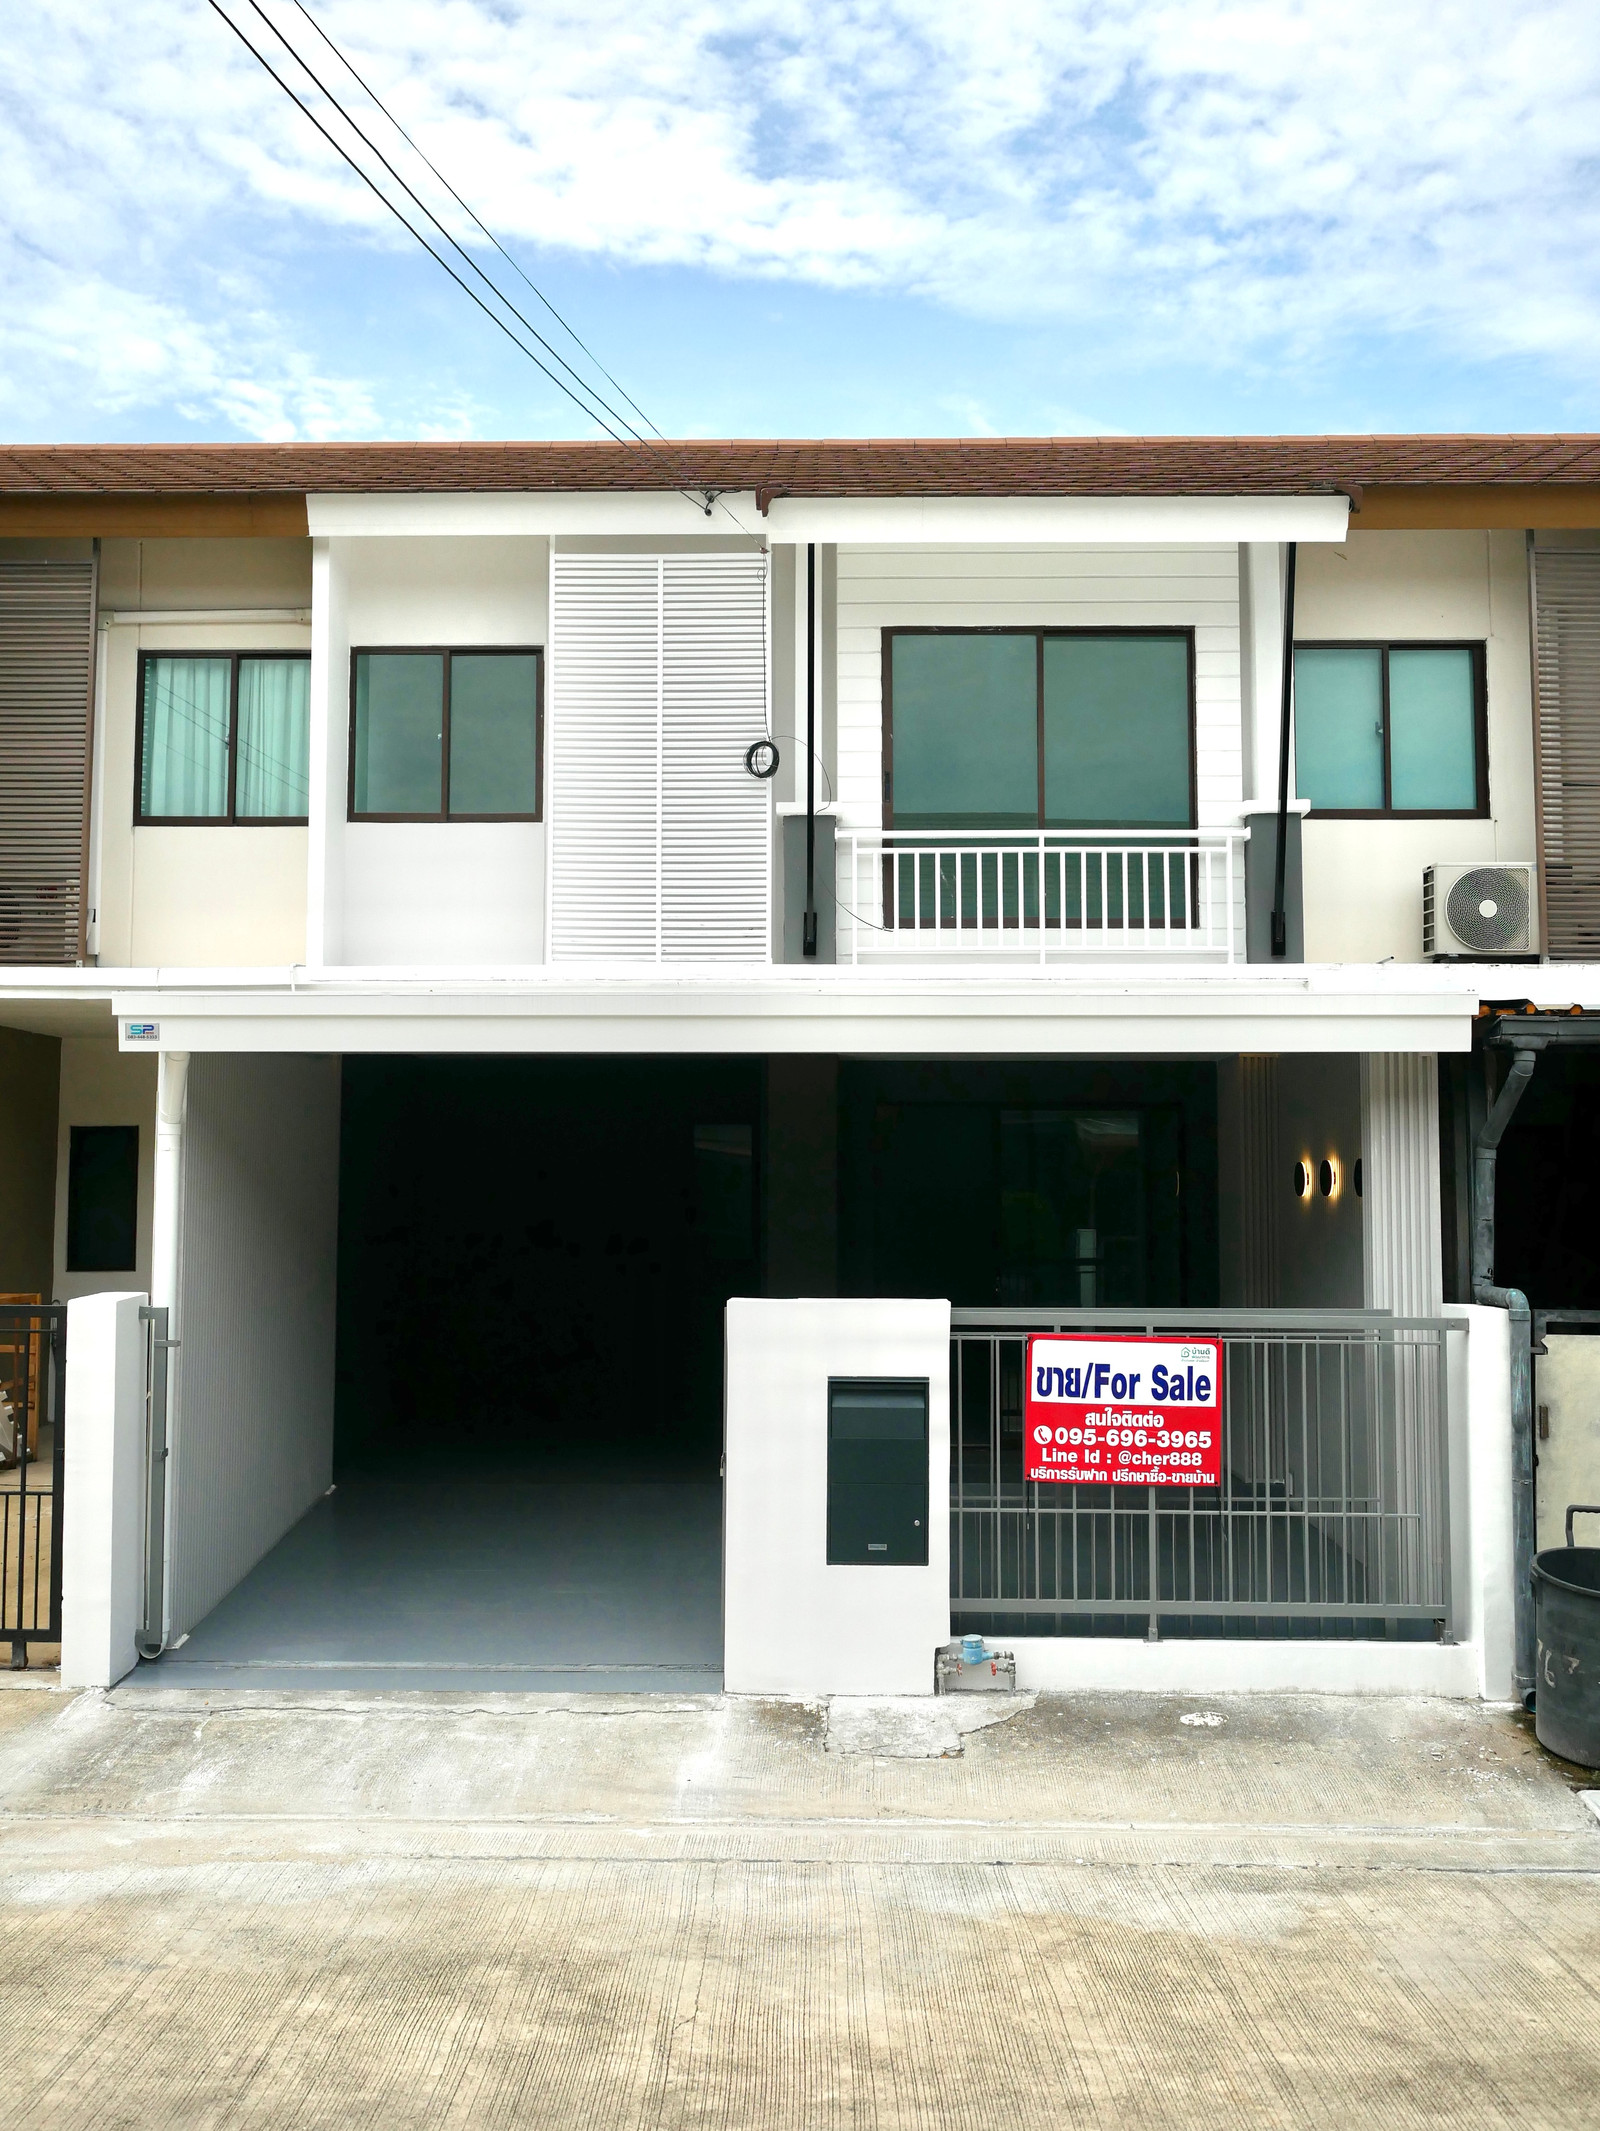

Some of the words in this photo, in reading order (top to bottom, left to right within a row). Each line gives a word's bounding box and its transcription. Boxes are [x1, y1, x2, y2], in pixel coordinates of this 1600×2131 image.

[1037, 1362, 1140, 1399] ขาย/For
[1151, 1364, 1211, 1401] Sale
[1085, 1407, 1164, 1428] สนใจติดต่อ
[1054, 1428, 1212, 1449] 095-696-3965
[1042, 1448, 1078, 1463] Line
[1084, 1449, 1100, 1464] Id
[1118, 1451, 1203, 1466] @cher888
[1030, 1466, 1108, 1481] บริการรับฝาก
[1112, 1466, 1215, 1484] ปรึกษาซื้อ-ขายบ้าน
